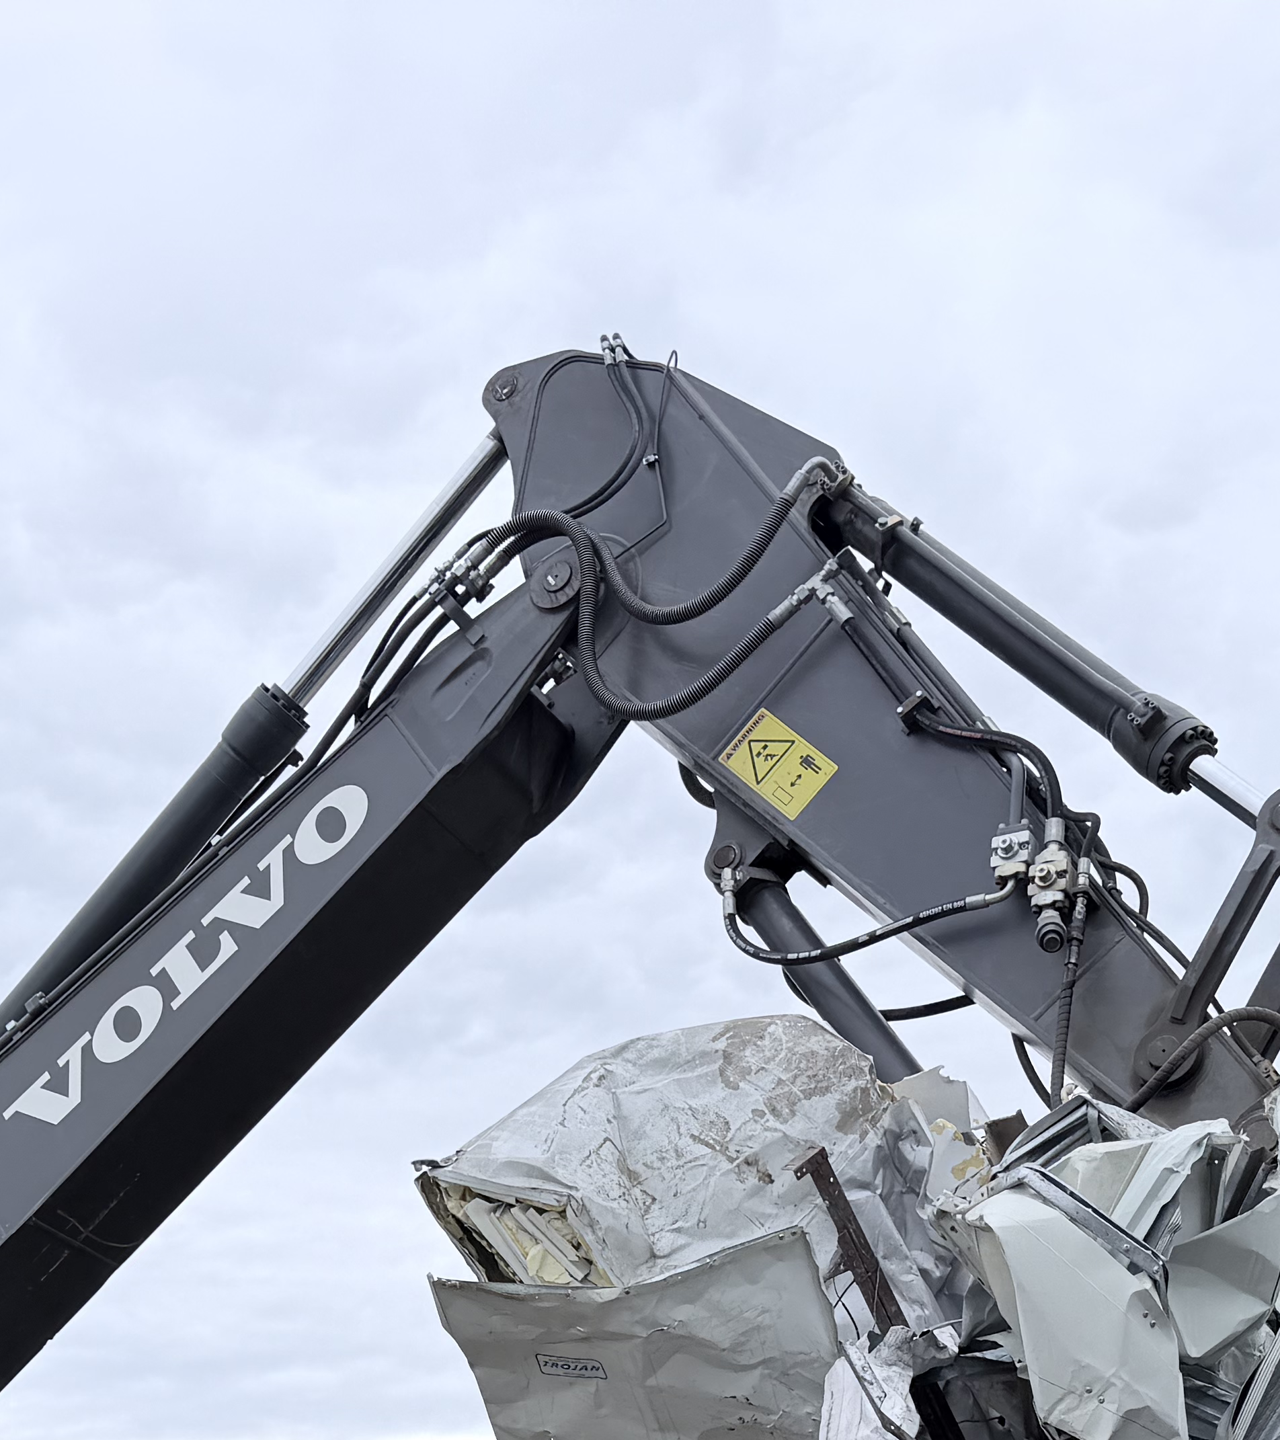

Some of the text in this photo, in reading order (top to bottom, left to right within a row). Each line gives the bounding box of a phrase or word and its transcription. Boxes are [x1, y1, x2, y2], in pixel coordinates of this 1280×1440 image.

[731, 713, 767, 752] WARNING
[2, 783, 370, 1126] VOLVO
[541, 1360, 601, 1372] TROJAN
